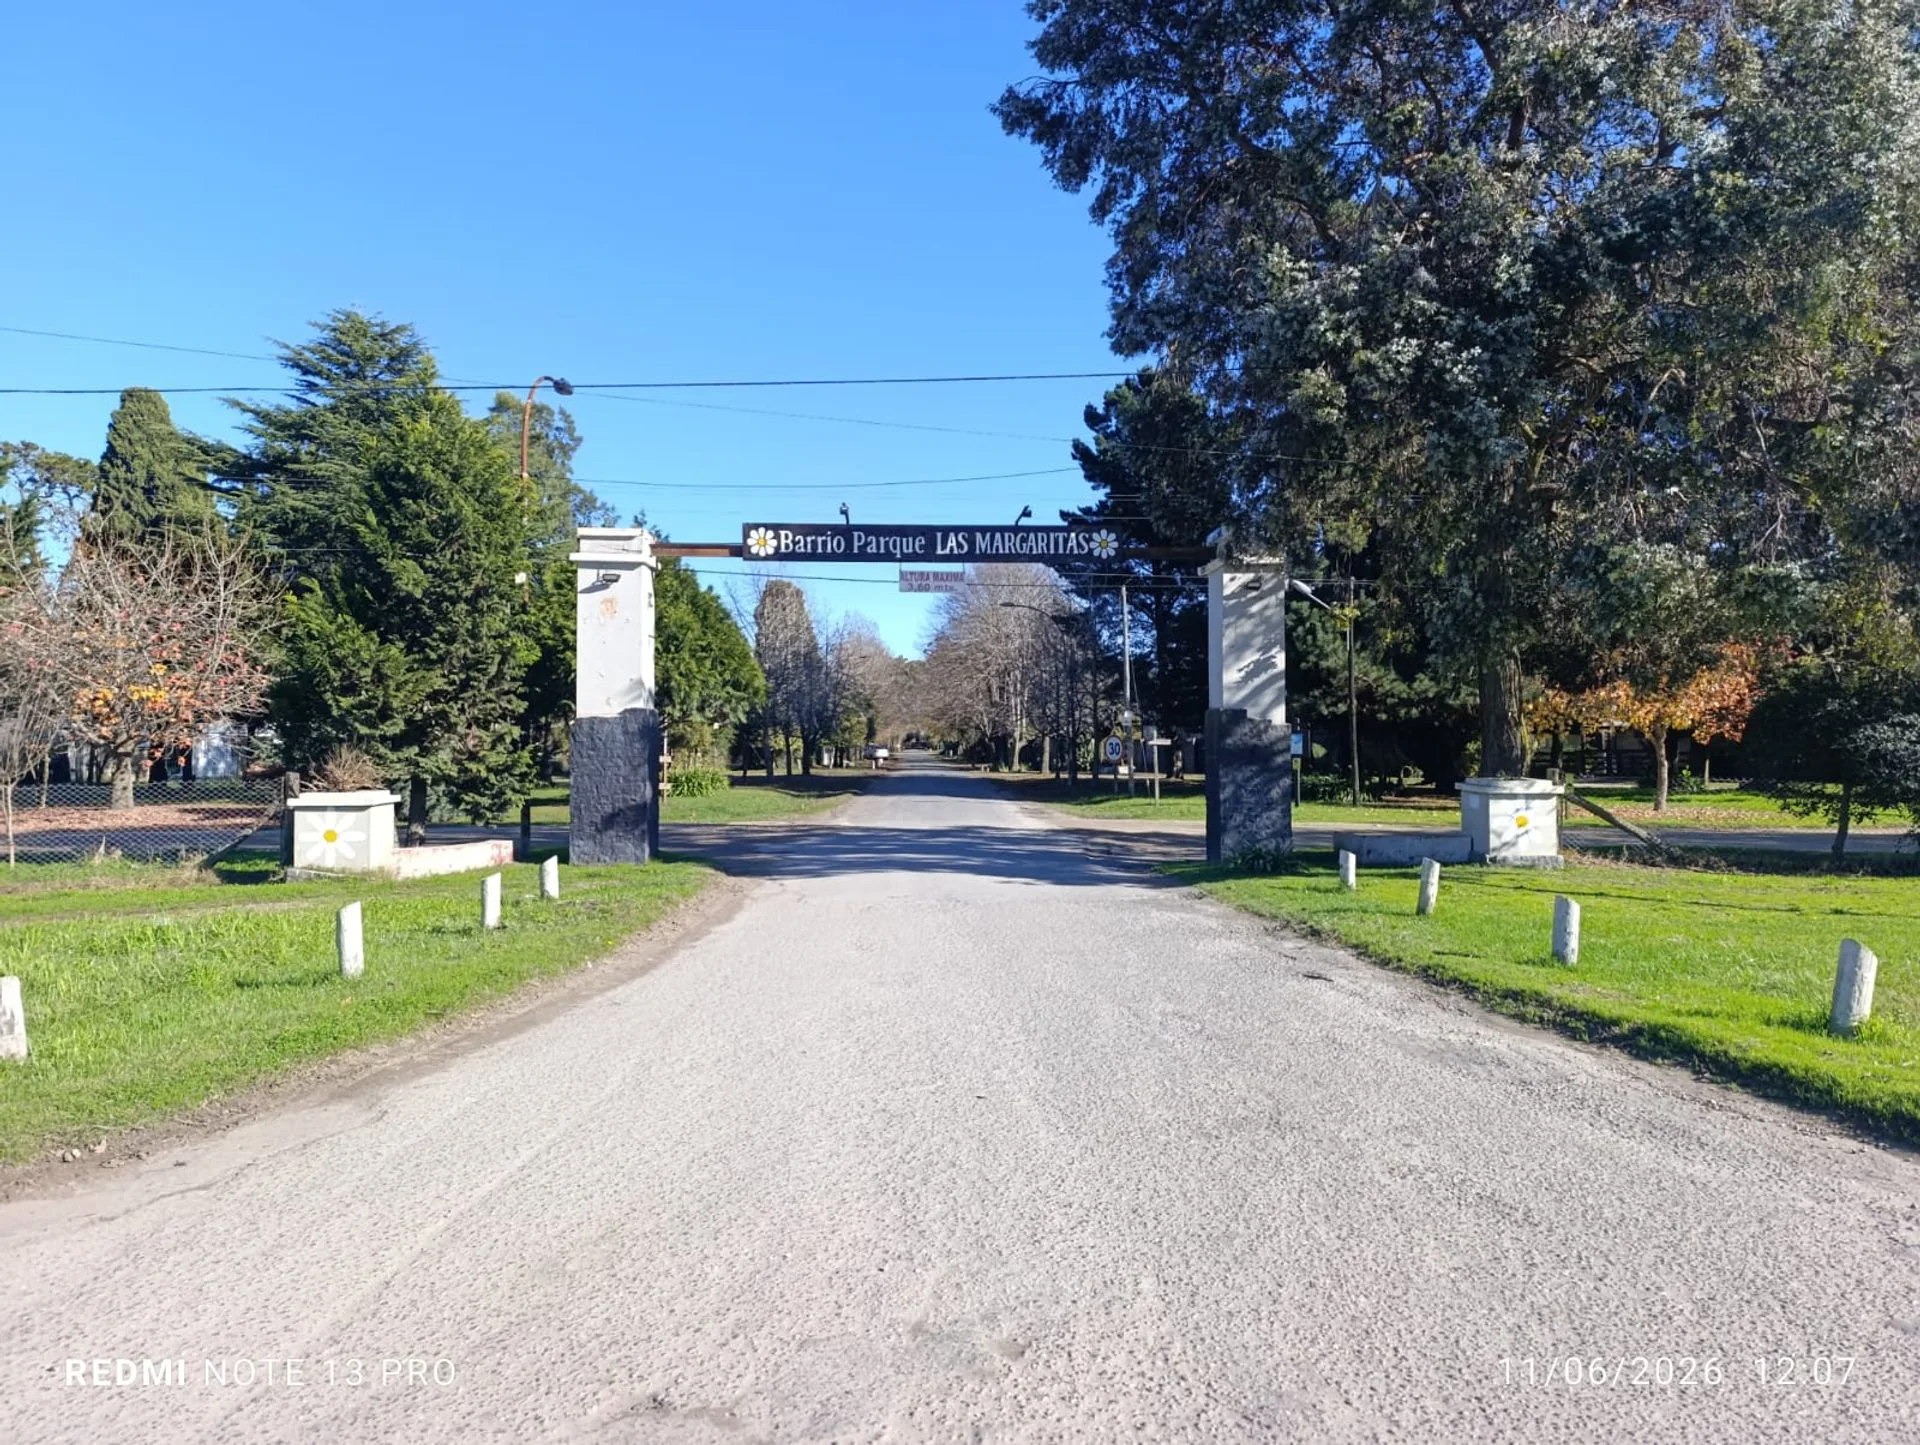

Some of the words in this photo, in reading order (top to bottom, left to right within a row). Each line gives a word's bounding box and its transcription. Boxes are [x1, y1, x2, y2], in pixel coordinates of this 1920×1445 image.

[778, 530, 845, 554] Barrio
[852, 531, 926, 558] Parque
[935, 532, 968, 555] LAS
[975, 532, 1089, 555] MARGARITAS
[1108, 742, 1121, 756] 30
